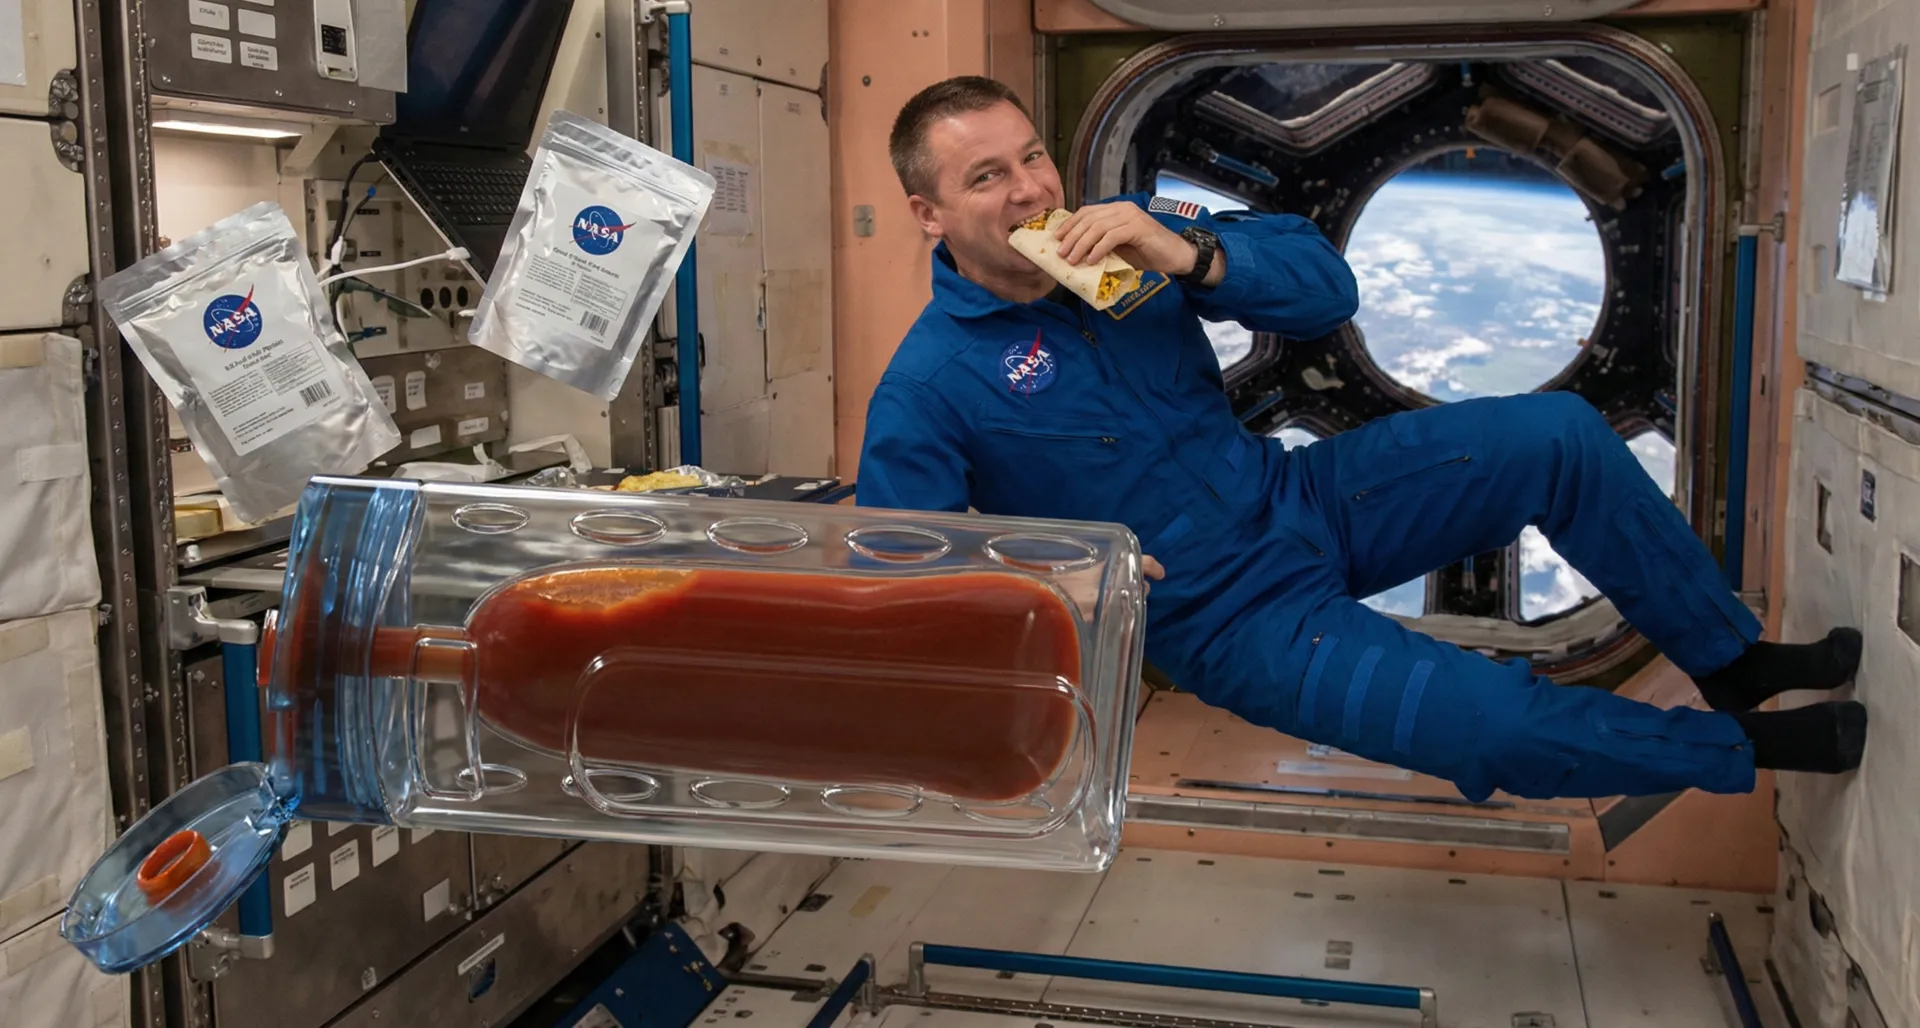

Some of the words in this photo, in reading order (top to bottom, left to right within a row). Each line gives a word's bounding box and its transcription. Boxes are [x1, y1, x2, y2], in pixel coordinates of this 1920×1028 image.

[577, 217, 619, 244] NASA
[209, 307, 258, 337] NASA
[1007, 349, 1050, 384] NASA
